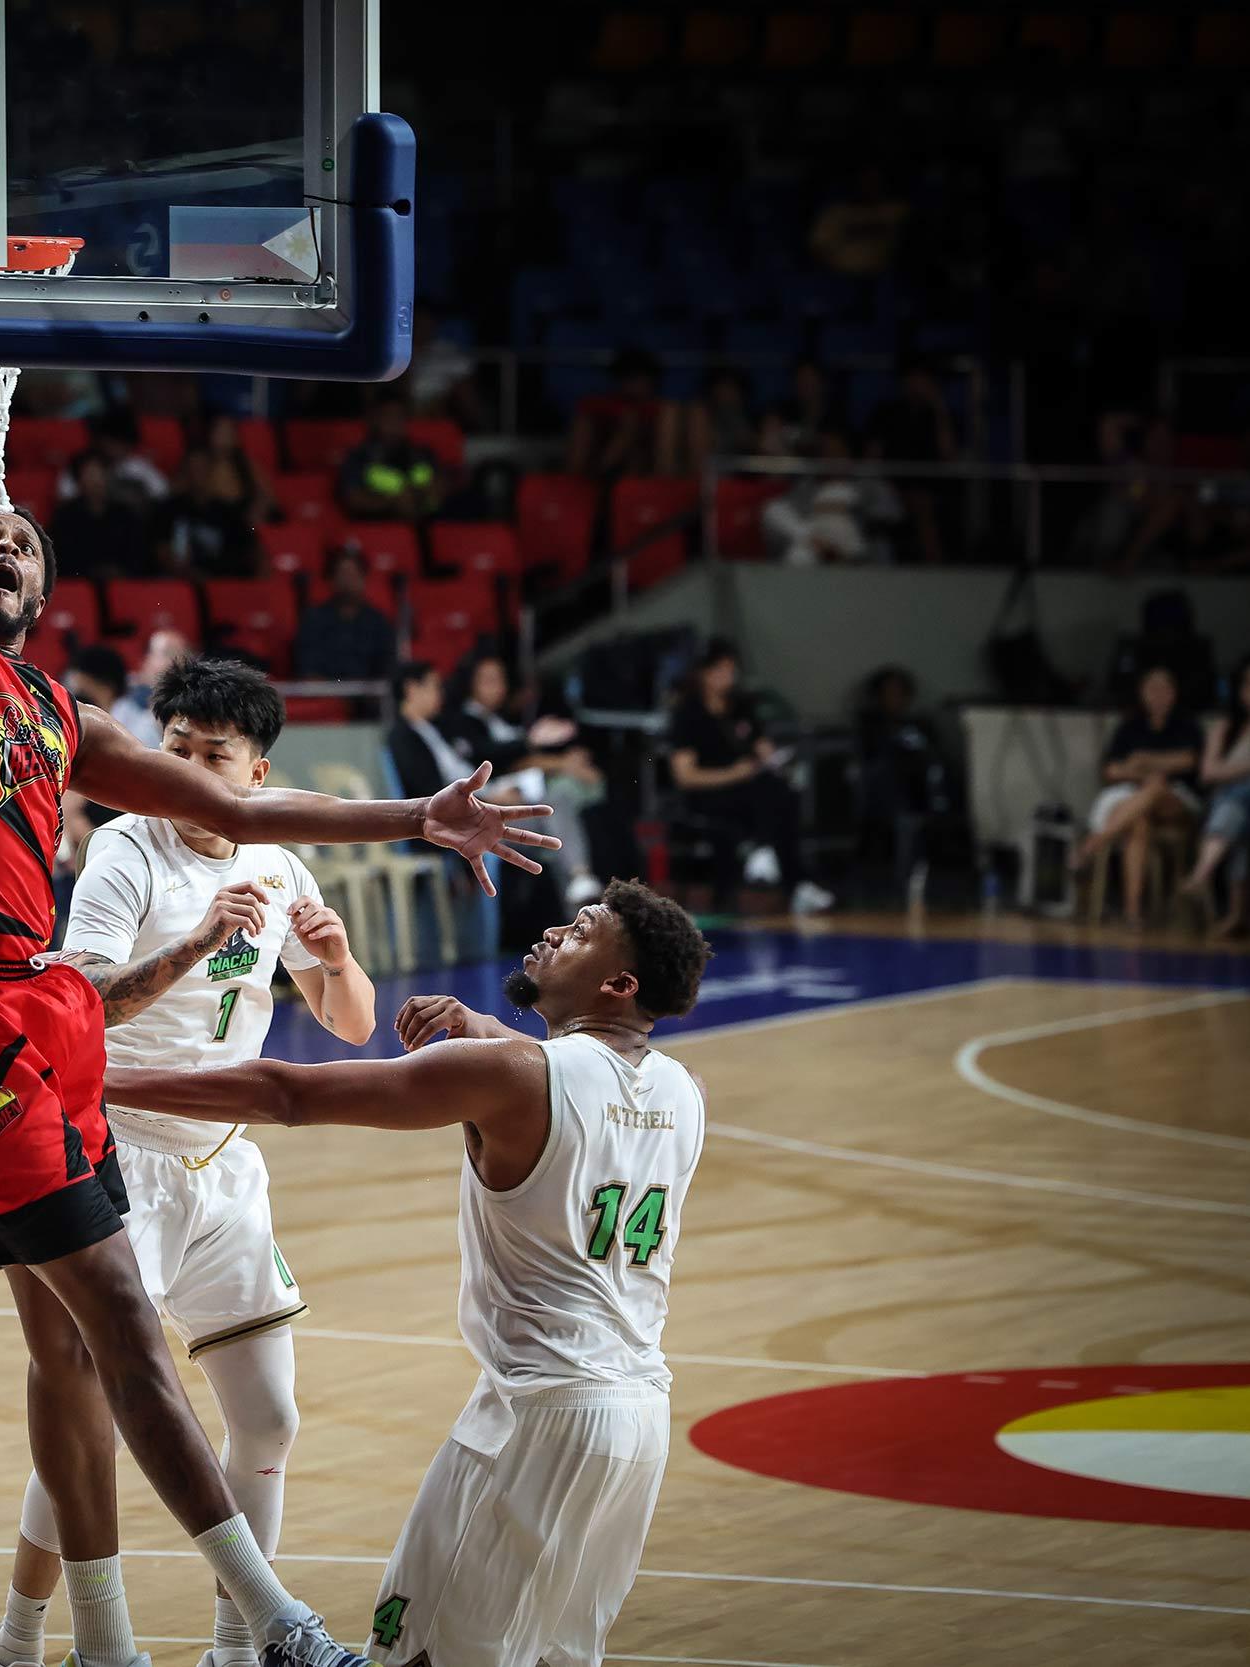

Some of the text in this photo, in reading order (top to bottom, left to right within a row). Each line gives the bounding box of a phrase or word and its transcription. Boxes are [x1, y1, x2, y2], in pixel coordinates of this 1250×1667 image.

[207, 948, 260, 976] MACAU
[212, 987, 241, 1043] 1
[606, 1102, 675, 1131] MITCHELL
[585, 1181, 670, 1268] 14
[372, 1593, 411, 1648] 4
